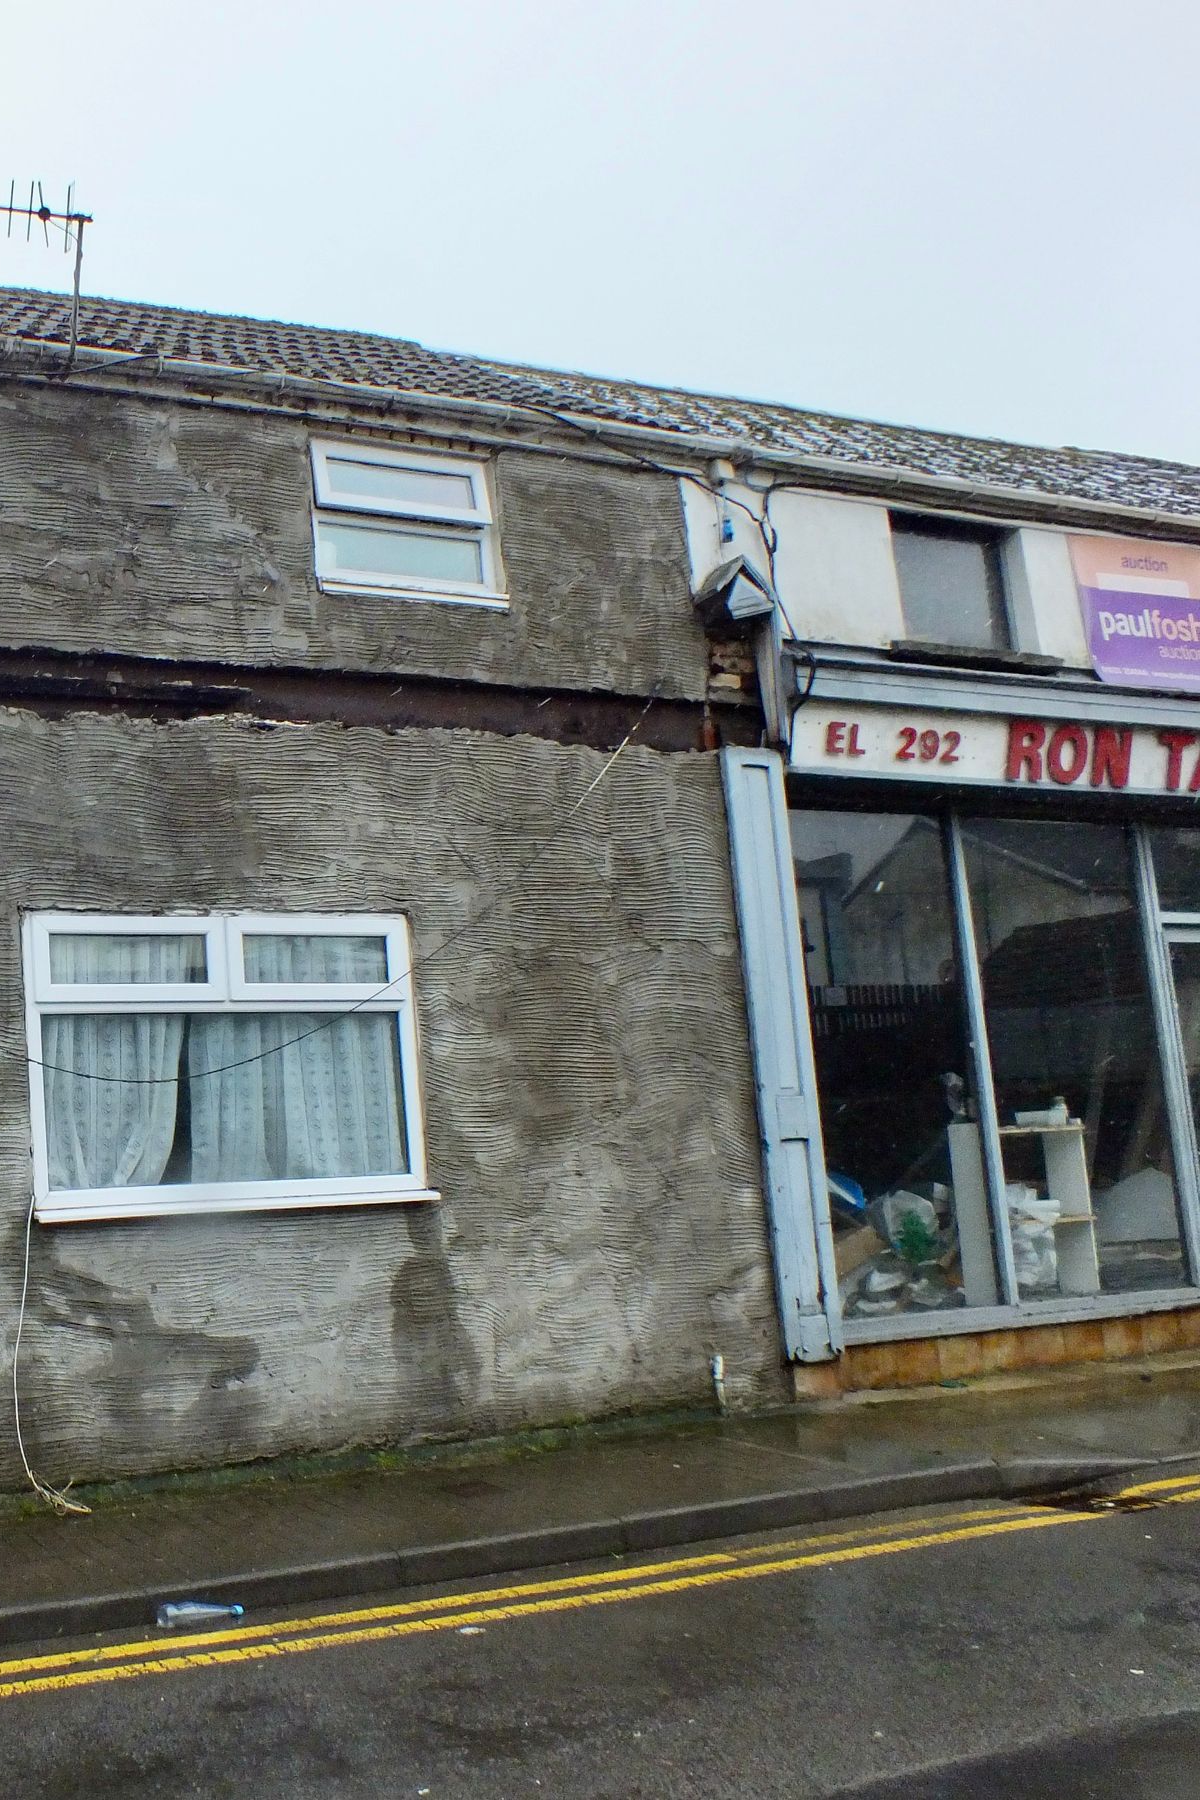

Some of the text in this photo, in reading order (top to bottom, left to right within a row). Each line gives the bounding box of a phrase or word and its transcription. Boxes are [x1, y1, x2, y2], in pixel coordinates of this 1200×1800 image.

[1121, 556, 1168, 572] auction
[826, 721, 866, 756] EL
[895, 726, 961, 763] 292
[1005, 719, 1133, 789] RON
